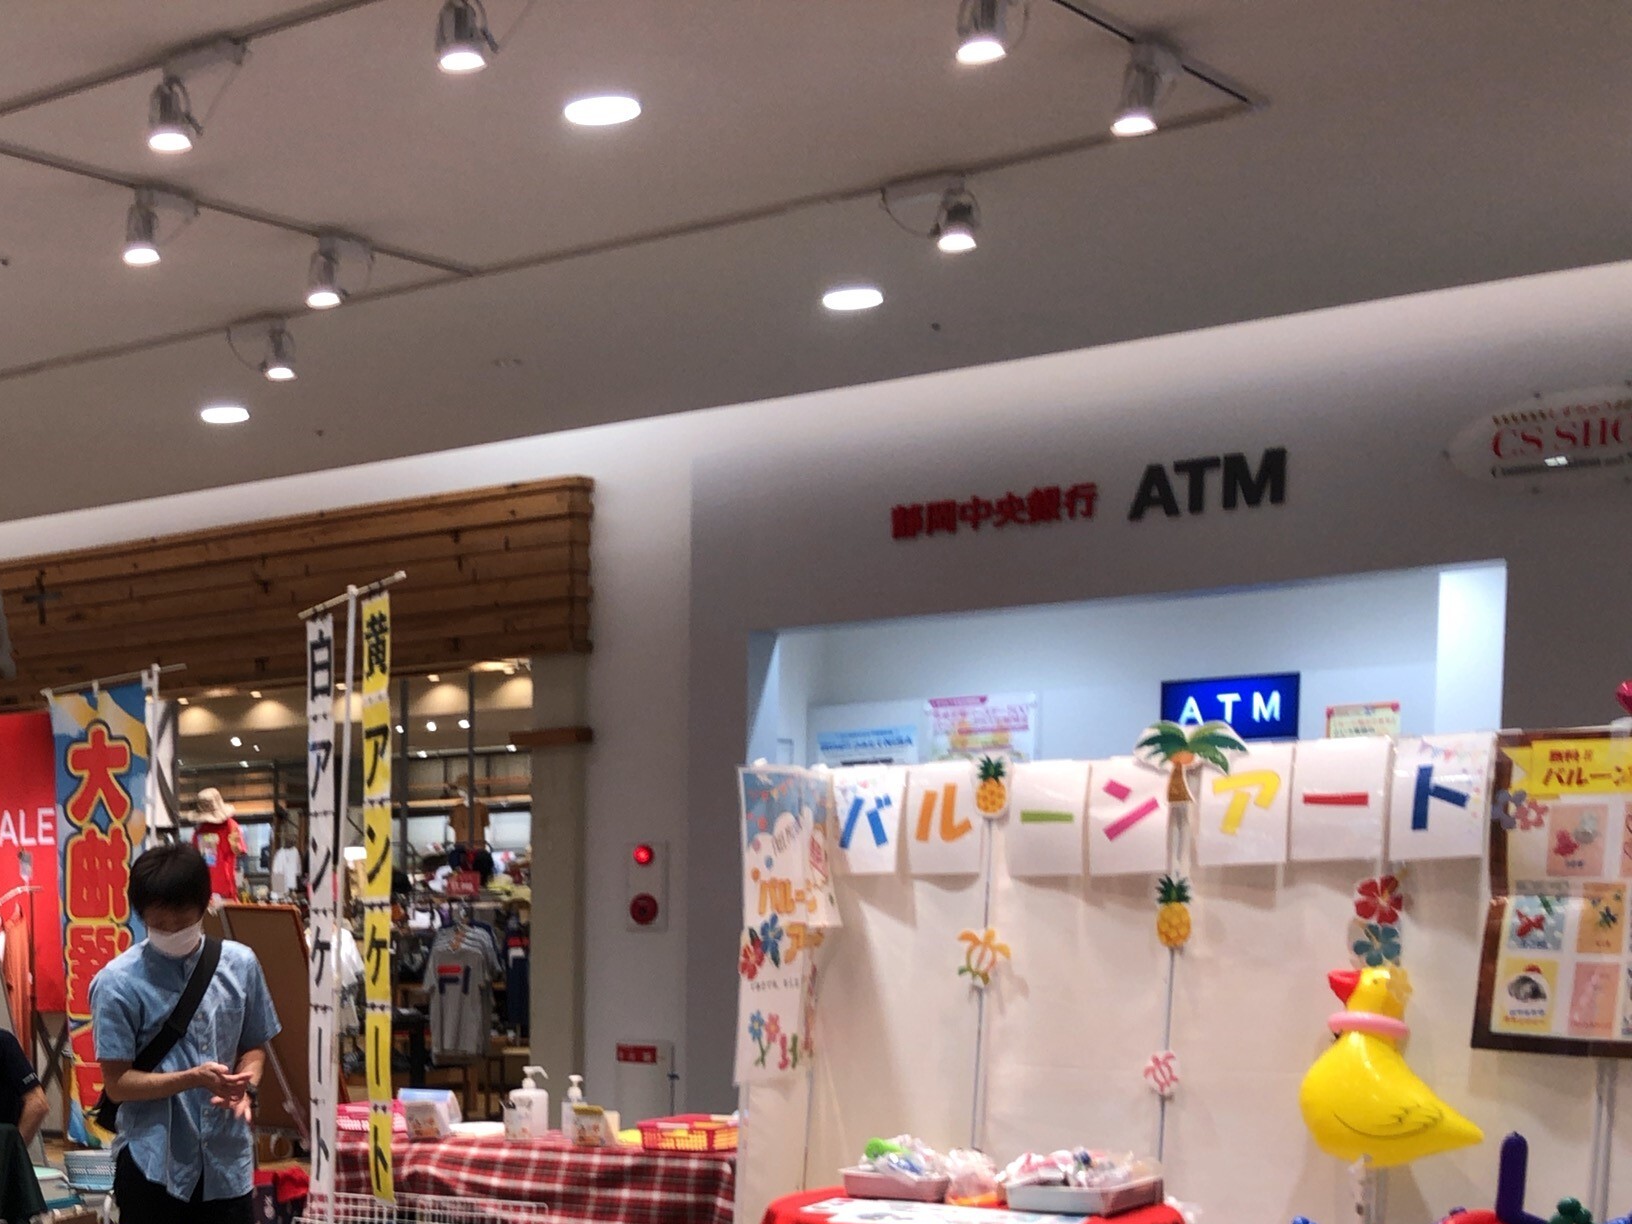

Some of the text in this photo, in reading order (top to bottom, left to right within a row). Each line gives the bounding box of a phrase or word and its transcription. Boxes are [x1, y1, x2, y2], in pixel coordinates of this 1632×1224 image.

[1127, 447, 1287, 521] ATM
[1179, 690, 1281, 726] ATM
[838, 764, 1471, 850] バルーンアート
